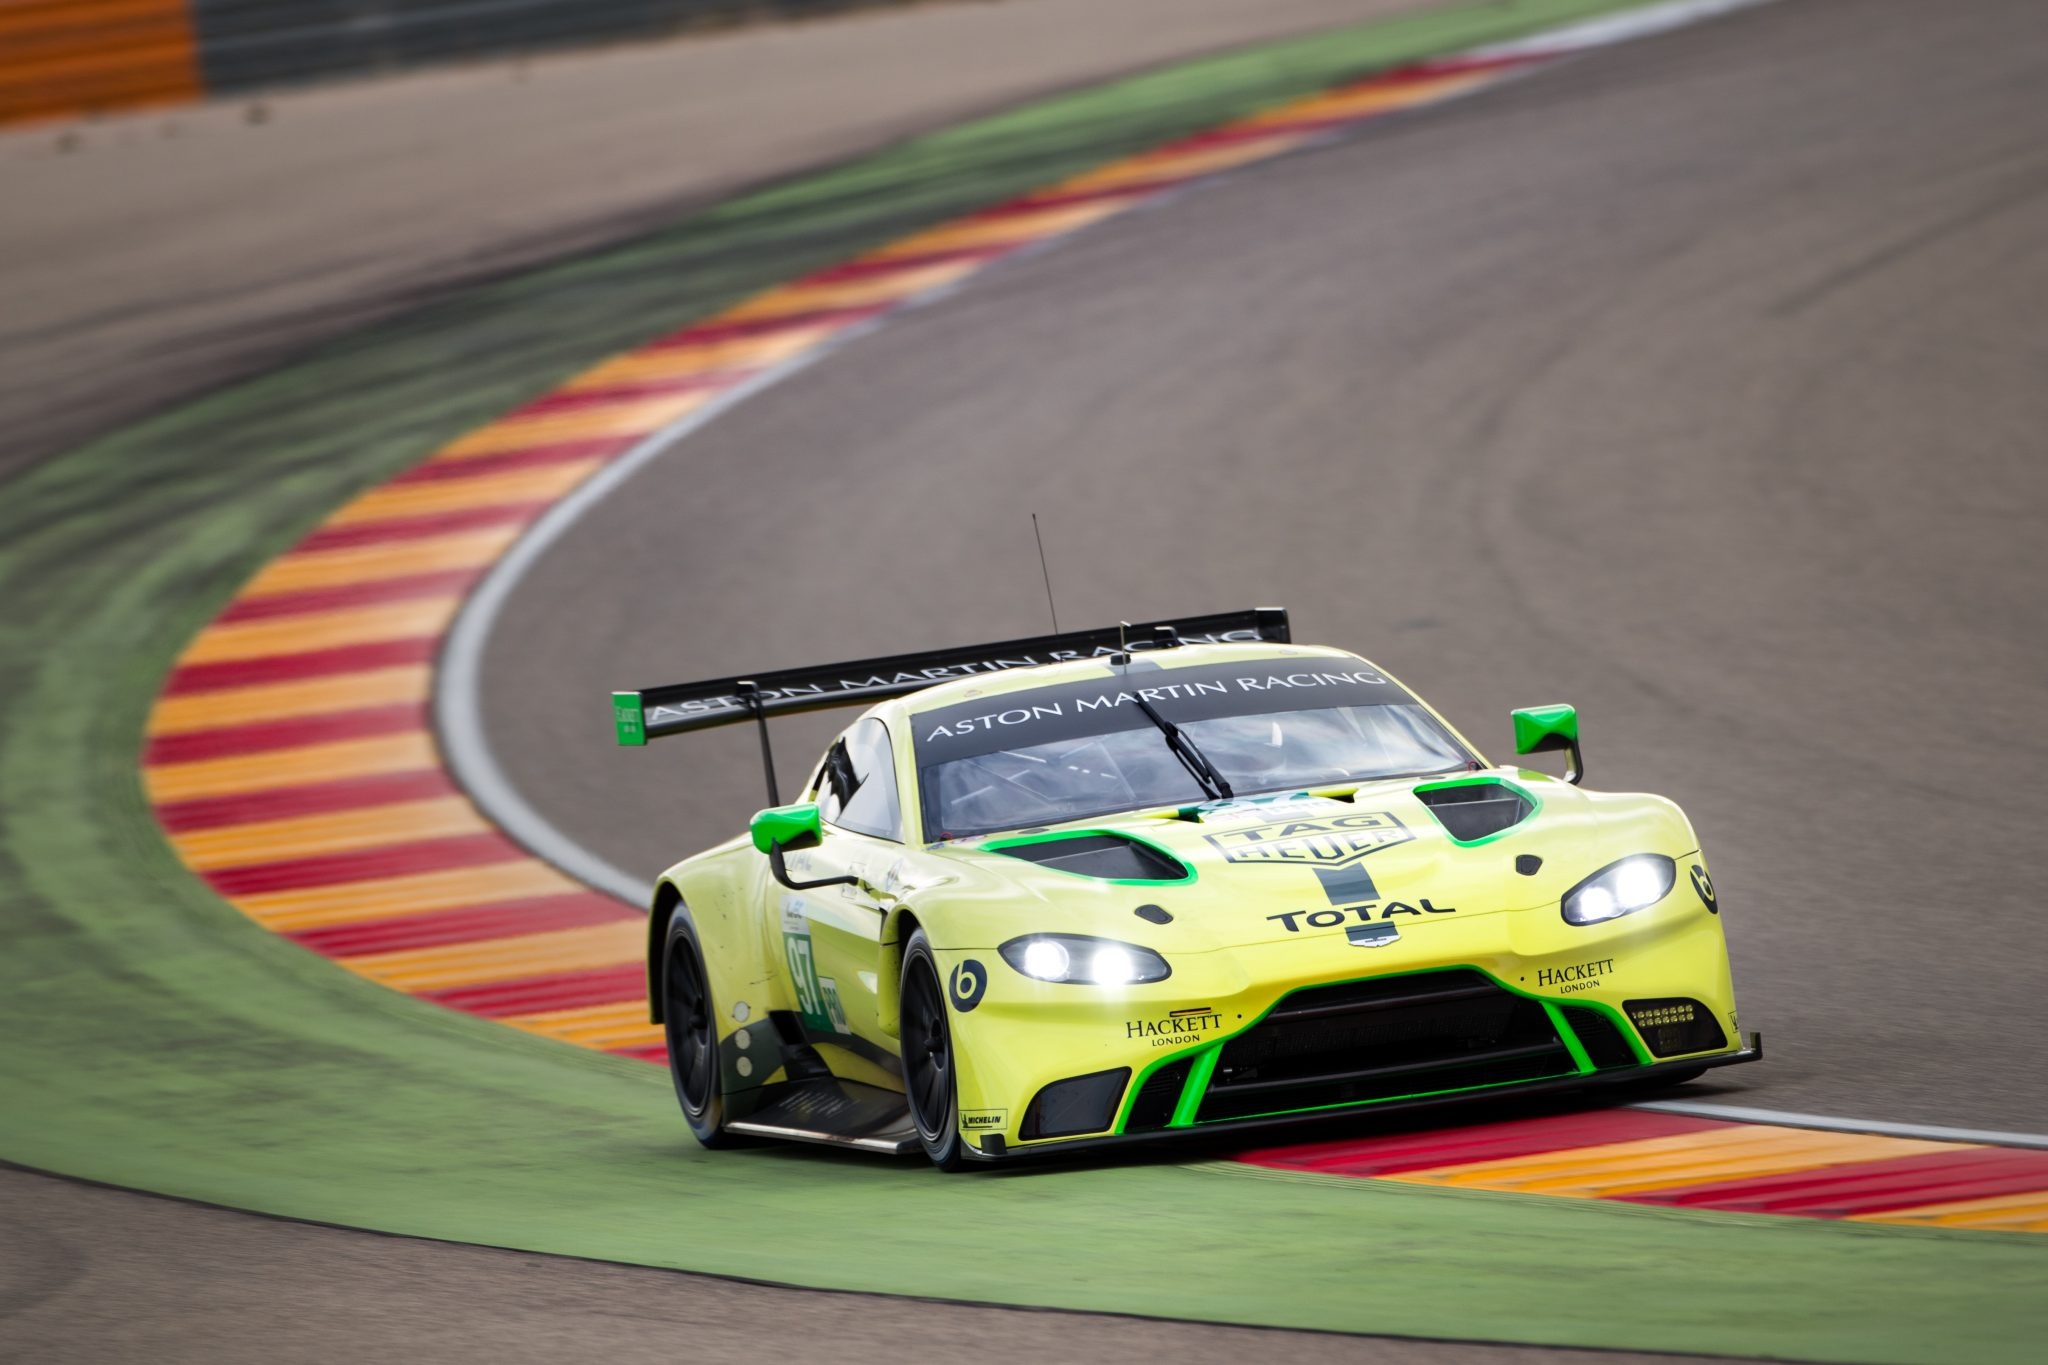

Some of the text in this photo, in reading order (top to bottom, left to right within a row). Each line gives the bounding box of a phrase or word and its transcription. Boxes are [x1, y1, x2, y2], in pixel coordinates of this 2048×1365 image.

[839, 655, 1039, 690] MARTIN
[926, 671, 1387, 742] ASTON MARTIN RACING
[1223, 815, 1382, 841] TAG
[1230, 830, 1398, 860] HEUER
[1266, 898, 1456, 932] TOTAL
[787, 936, 822, 1015] 97
[1537, 958, 1614, 987] HACKETT
[1559, 979, 1601, 994] LONDON
[1126, 1013, 1223, 1039] HACKETT
[1151, 1034, 1200, 1047] LONDON
[967, 1115, 1002, 1125] MICHELIN
